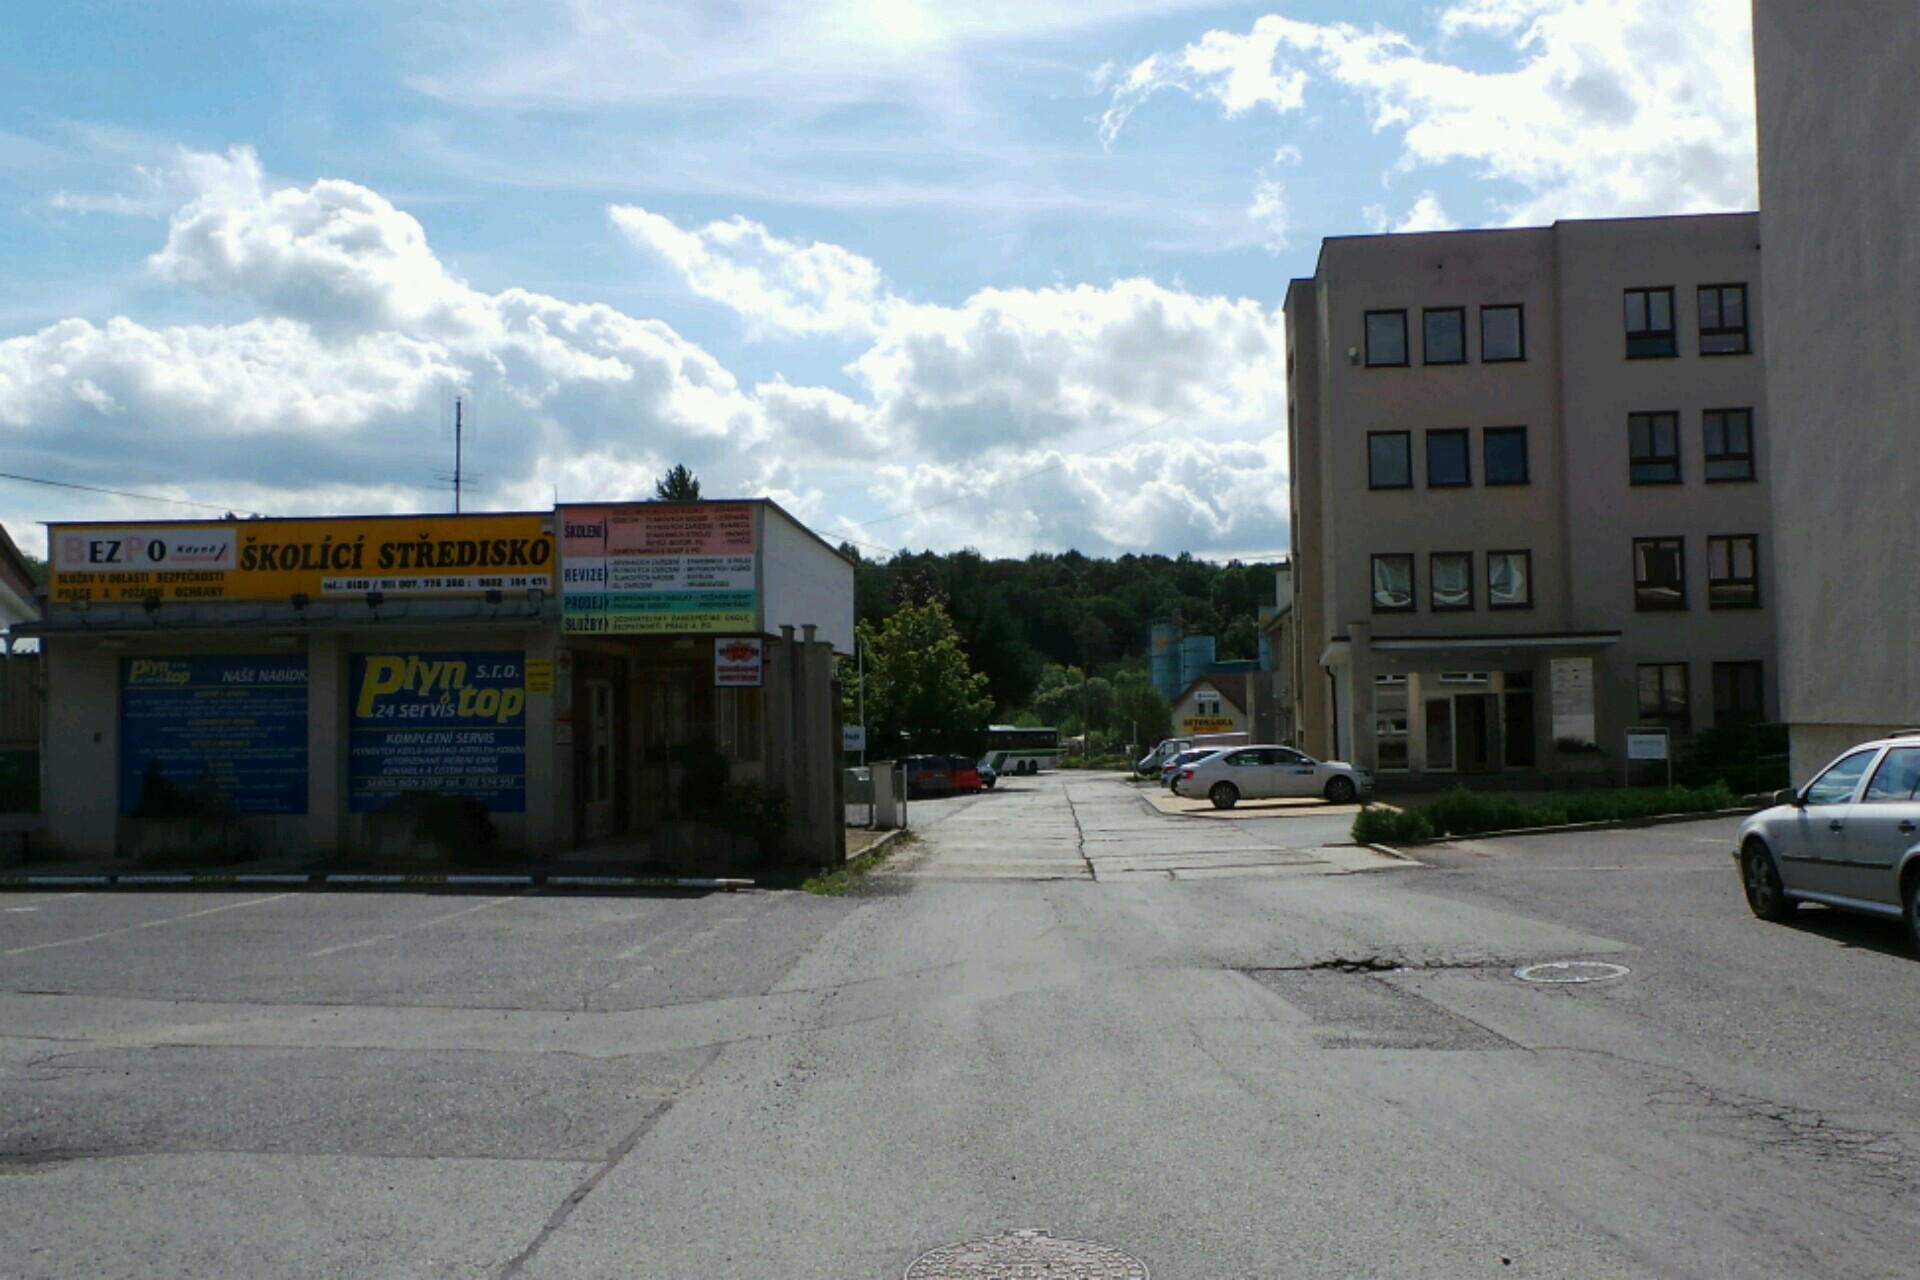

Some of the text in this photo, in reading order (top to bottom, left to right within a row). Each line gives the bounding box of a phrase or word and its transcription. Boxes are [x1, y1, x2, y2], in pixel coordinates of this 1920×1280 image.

[564, 521, 604, 538] ŠKOLENÍ
[241, 533, 550, 571] ŠKOLÍCÍ STŘEDISKO
[57, 569, 225, 584] SLUŽBY V OBLASTI BEZPEČNOSTI
[564, 568, 603, 583] REVIZE
[175, 586, 224, 597] OCHRANY
[564, 595, 604, 610] PRODEJ
[564, 613, 604, 632] SLUŽBY
[222, 667, 257, 682] NAŠE
[475, 664, 521, 679] s.r.o.
[356, 655, 467, 719] Plyn
[375, 701, 457, 719] 24 servis
[457, 683, 525, 724] top
[385, 731, 497, 745] KOMPLETNÍ SERVIS
